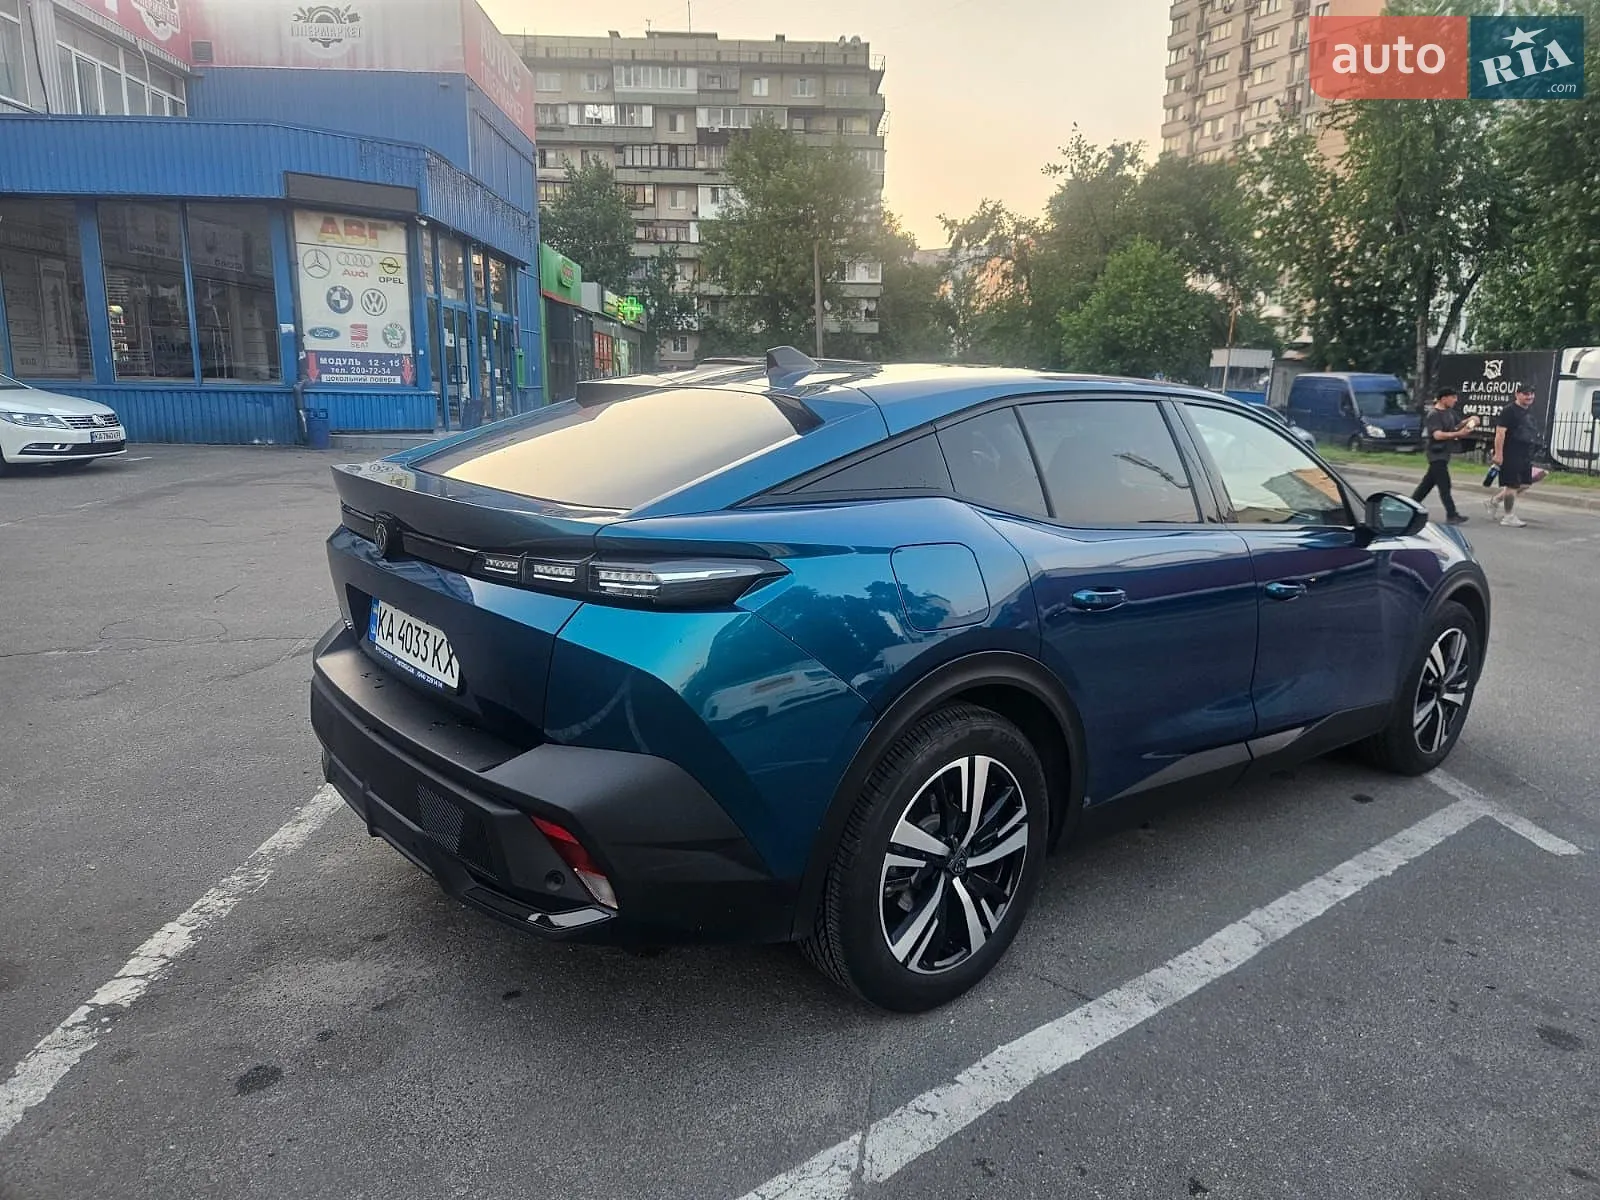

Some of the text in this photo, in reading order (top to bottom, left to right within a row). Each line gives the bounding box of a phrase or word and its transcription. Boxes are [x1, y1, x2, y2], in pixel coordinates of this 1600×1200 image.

[342, 268, 369, 278] Audi
[379, 276, 404, 285] OPEL
[314, 329, 335, 338] Ford
[320, 357, 360, 367] МОДУЛЬ
[368, 359, 380, 367] 12
[378, 606, 394, 645] KA
[398, 619, 430, 663] 4033
[432, 635, 455, 678] KX
